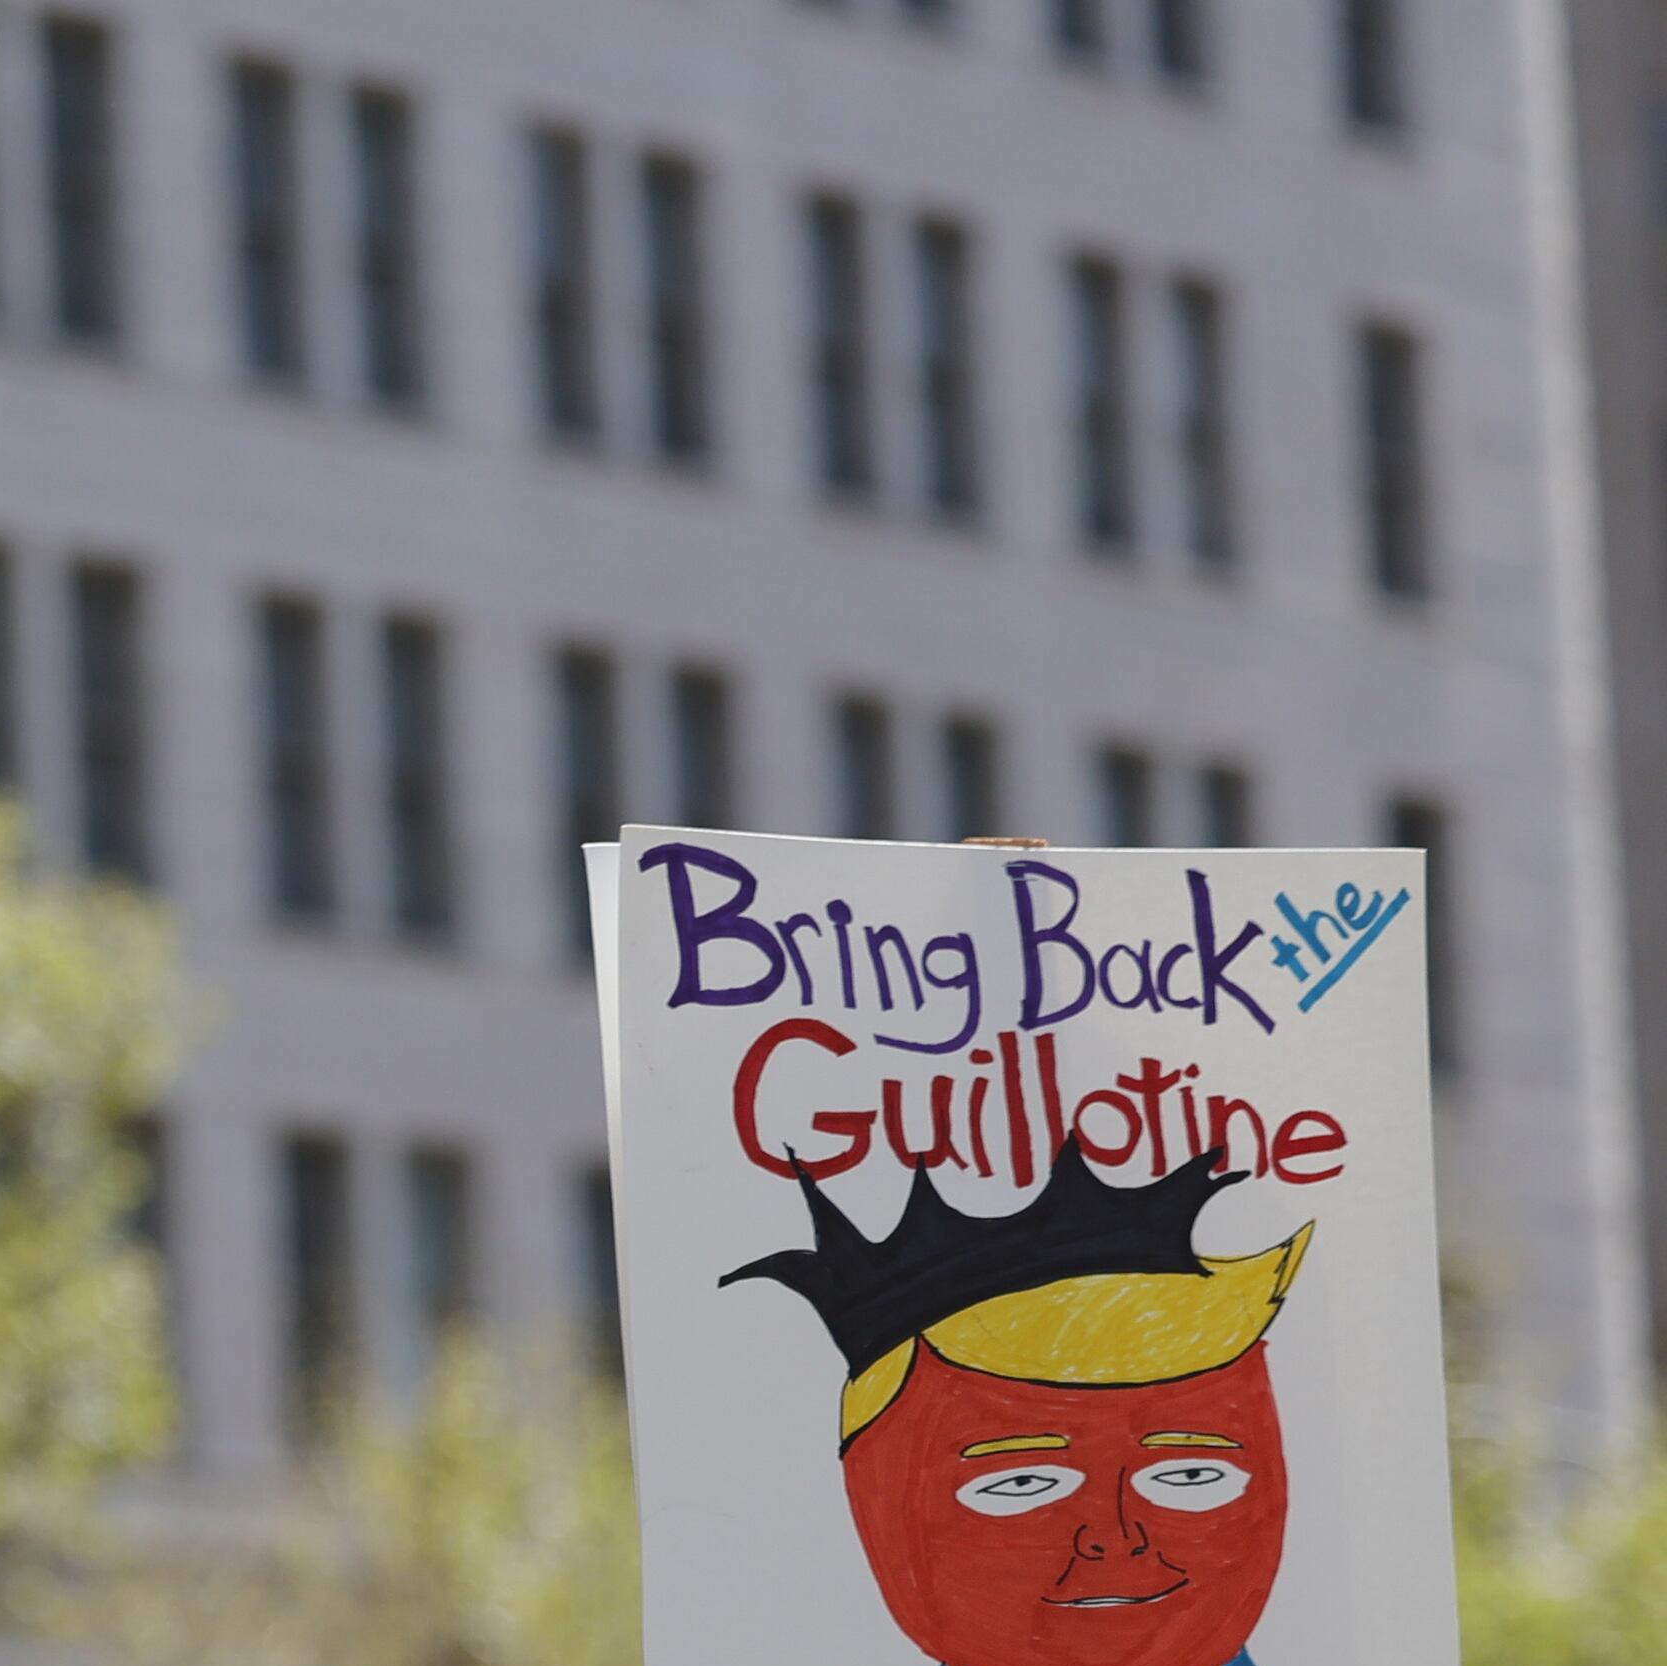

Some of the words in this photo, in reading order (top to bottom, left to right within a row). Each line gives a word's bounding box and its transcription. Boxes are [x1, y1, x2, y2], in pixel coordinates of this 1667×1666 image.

[638, 841, 981, 1055] Bring
[1005, 860, 1277, 1036] Back
[1270, 880, 1391, 985] the
[733, 1017, 1349, 1188] Guillotine
